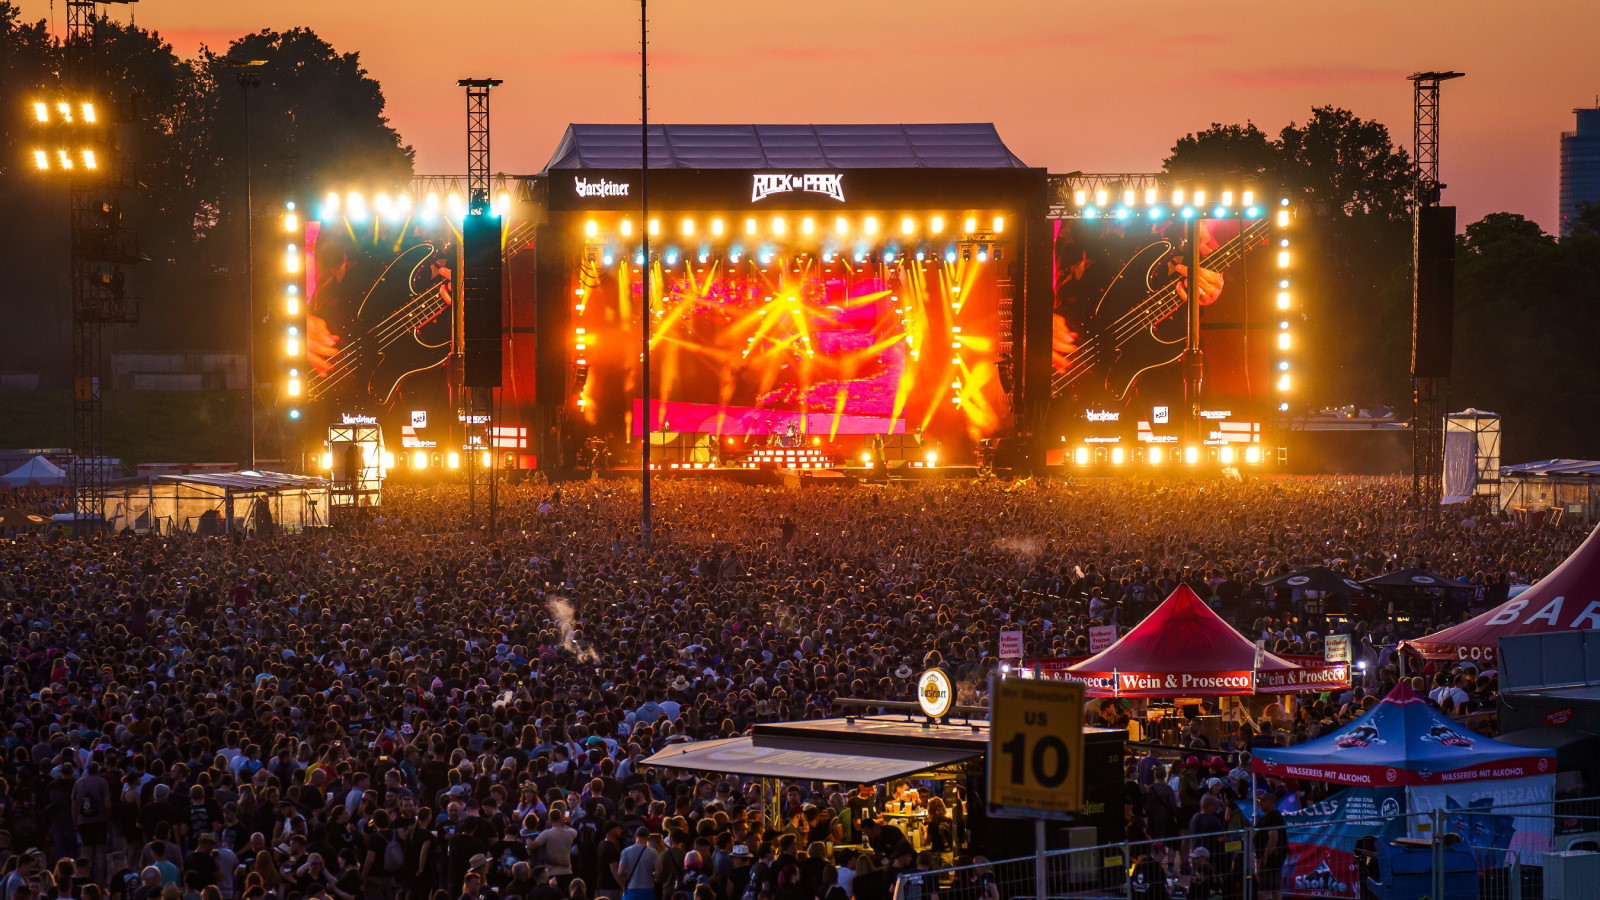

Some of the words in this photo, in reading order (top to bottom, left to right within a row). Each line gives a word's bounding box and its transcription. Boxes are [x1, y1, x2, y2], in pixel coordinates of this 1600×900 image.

[574, 176, 629, 198] Warsteiner
[752, 174, 793, 202] ROCK
[803, 174, 845, 202] PARK
[1326, 639, 1348, 647] Erdbeer
[1326, 651, 1348, 659] Cocktail
[1122, 674, 1161, 689] Wein
[1164, 674, 1178, 688] &
[1181, 674, 1249, 688] Prosecco
[1287, 670, 1297, 685] &
[1300, 668, 1345, 684] Prosecco
[1024, 711, 1048, 726] US
[1001, 732, 1070, 788] 10
[1286, 765, 1323, 778] WASSEREIS
[1324, 770, 1337, 779] MIT
[1338, 773, 1371, 783] ALKOHOL
[1441, 771, 1478, 781] WASSEREIS
[1479, 769, 1491, 778] MIT
[1492, 767, 1524, 777] ALKOHOL
